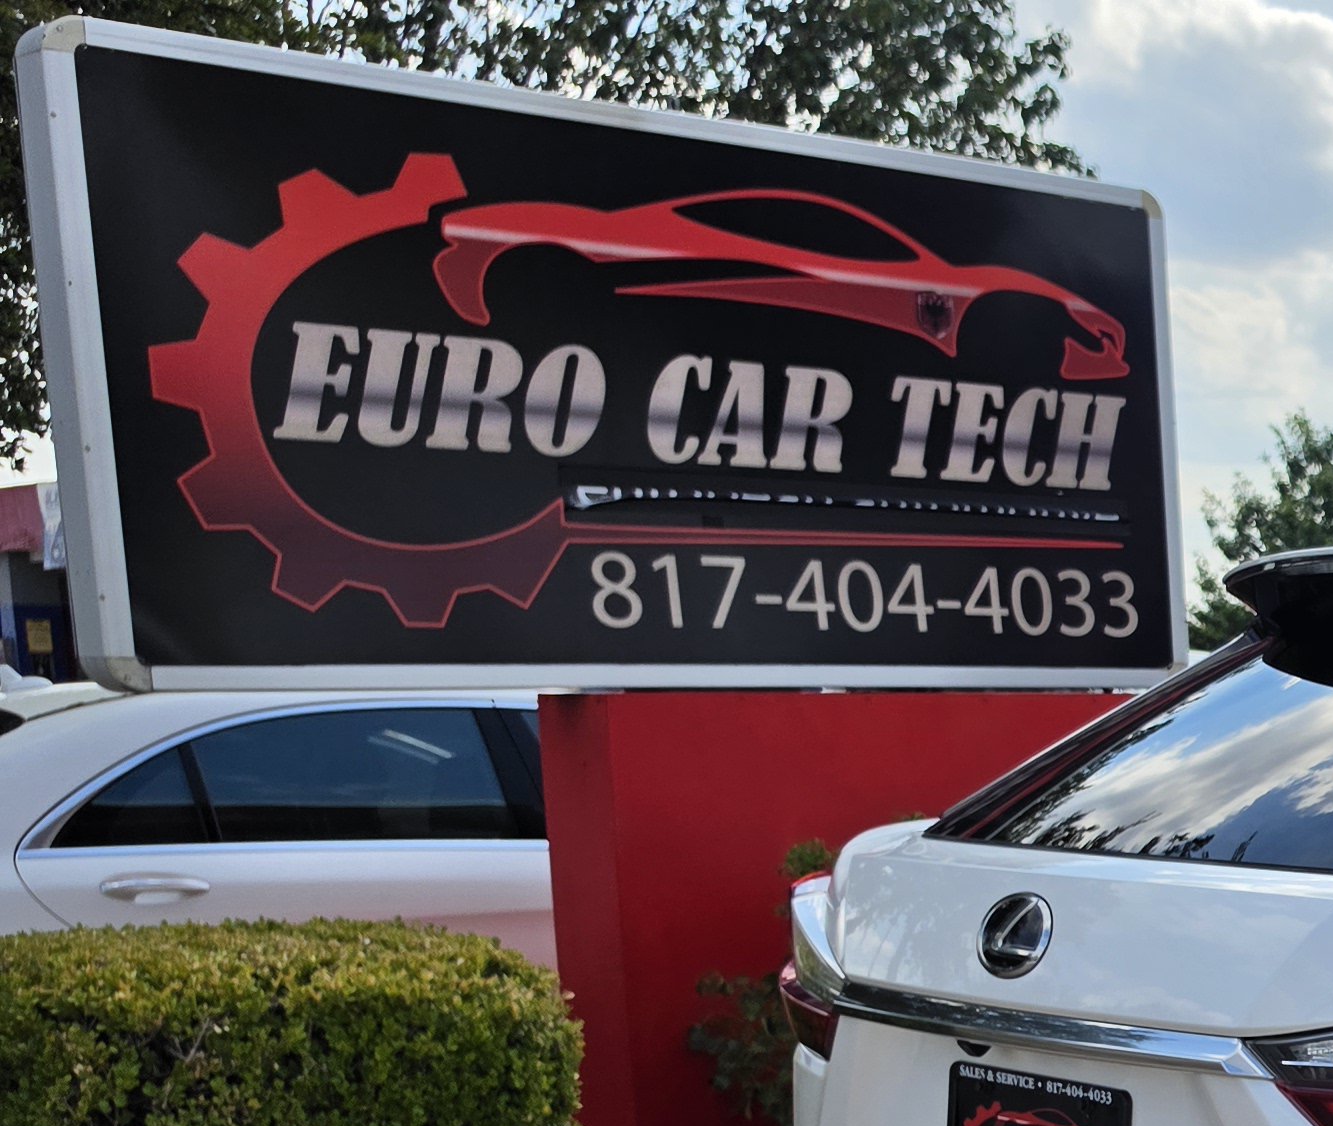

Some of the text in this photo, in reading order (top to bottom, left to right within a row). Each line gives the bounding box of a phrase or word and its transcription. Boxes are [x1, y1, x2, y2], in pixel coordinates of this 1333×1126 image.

[273, 321, 1127, 491] EURO CAR TECH
[590, 550, 1140, 638] 817-404-4033
[959, 1064, 1112, 1105] SALES & SERVICE 817-404-4033
